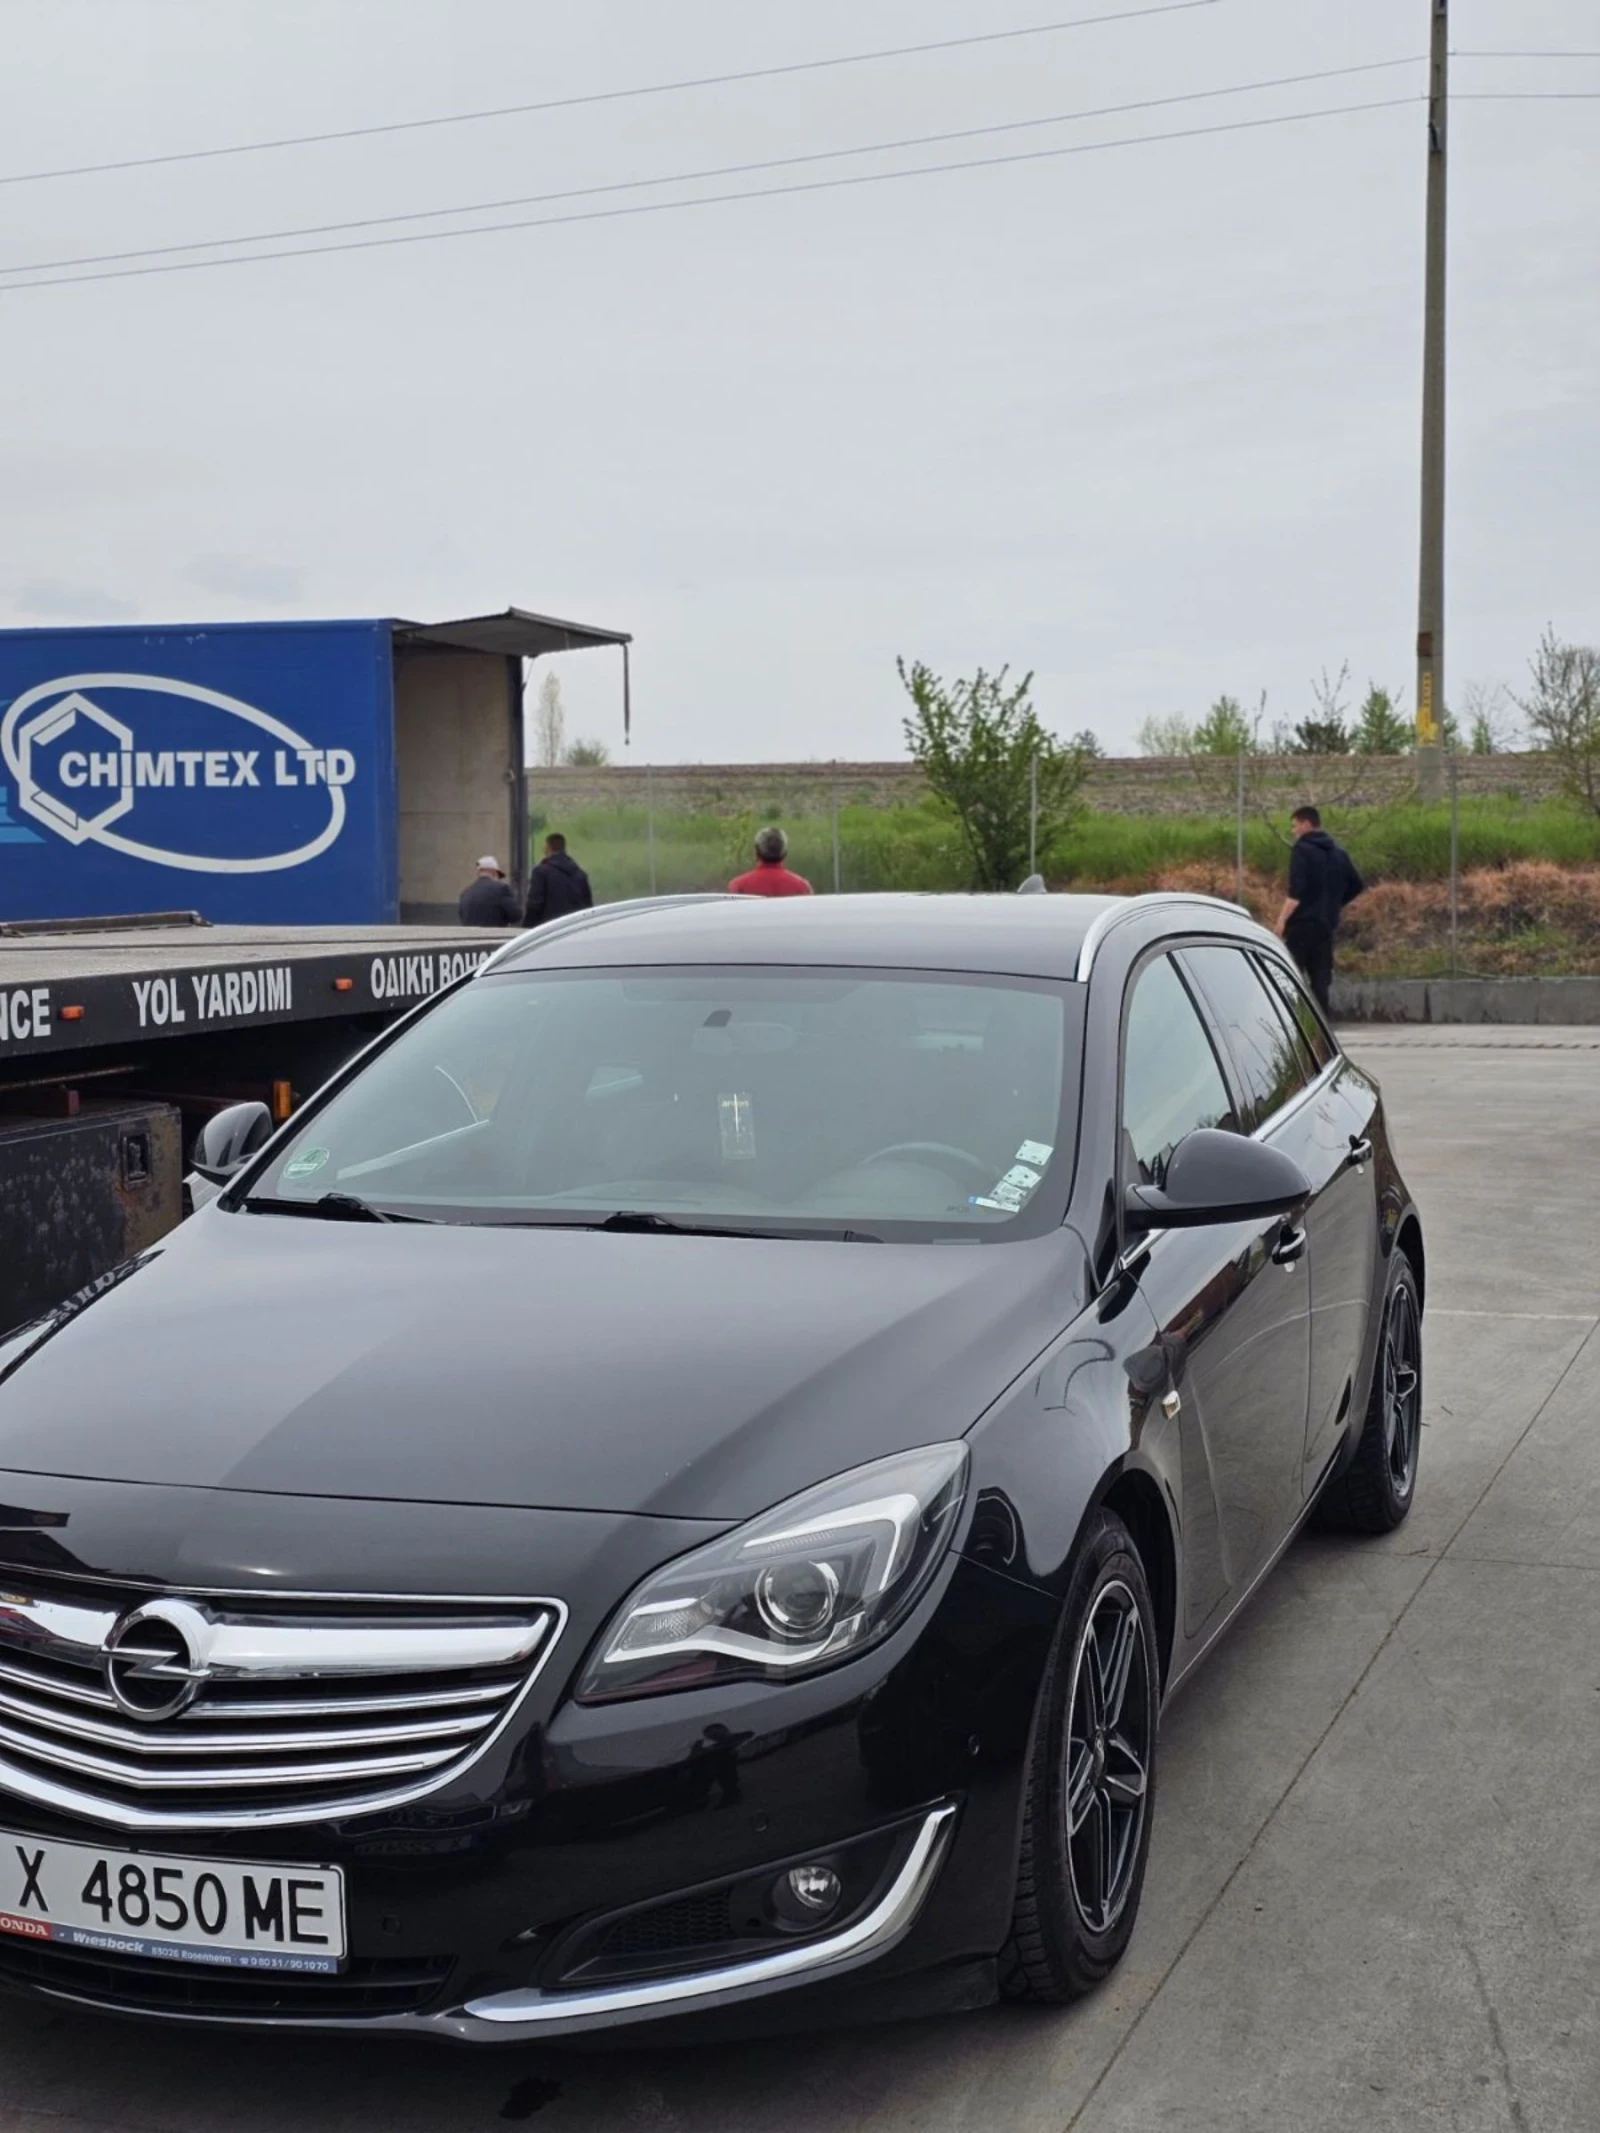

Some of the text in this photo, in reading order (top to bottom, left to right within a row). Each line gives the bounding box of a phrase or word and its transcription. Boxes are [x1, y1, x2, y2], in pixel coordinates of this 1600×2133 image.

[59, 748, 355, 787] CHIMTEX LTD
[132, 967, 292, 1027] YOL YARDIMI
[15, 1845, 329, 1944] X 4850 ME
